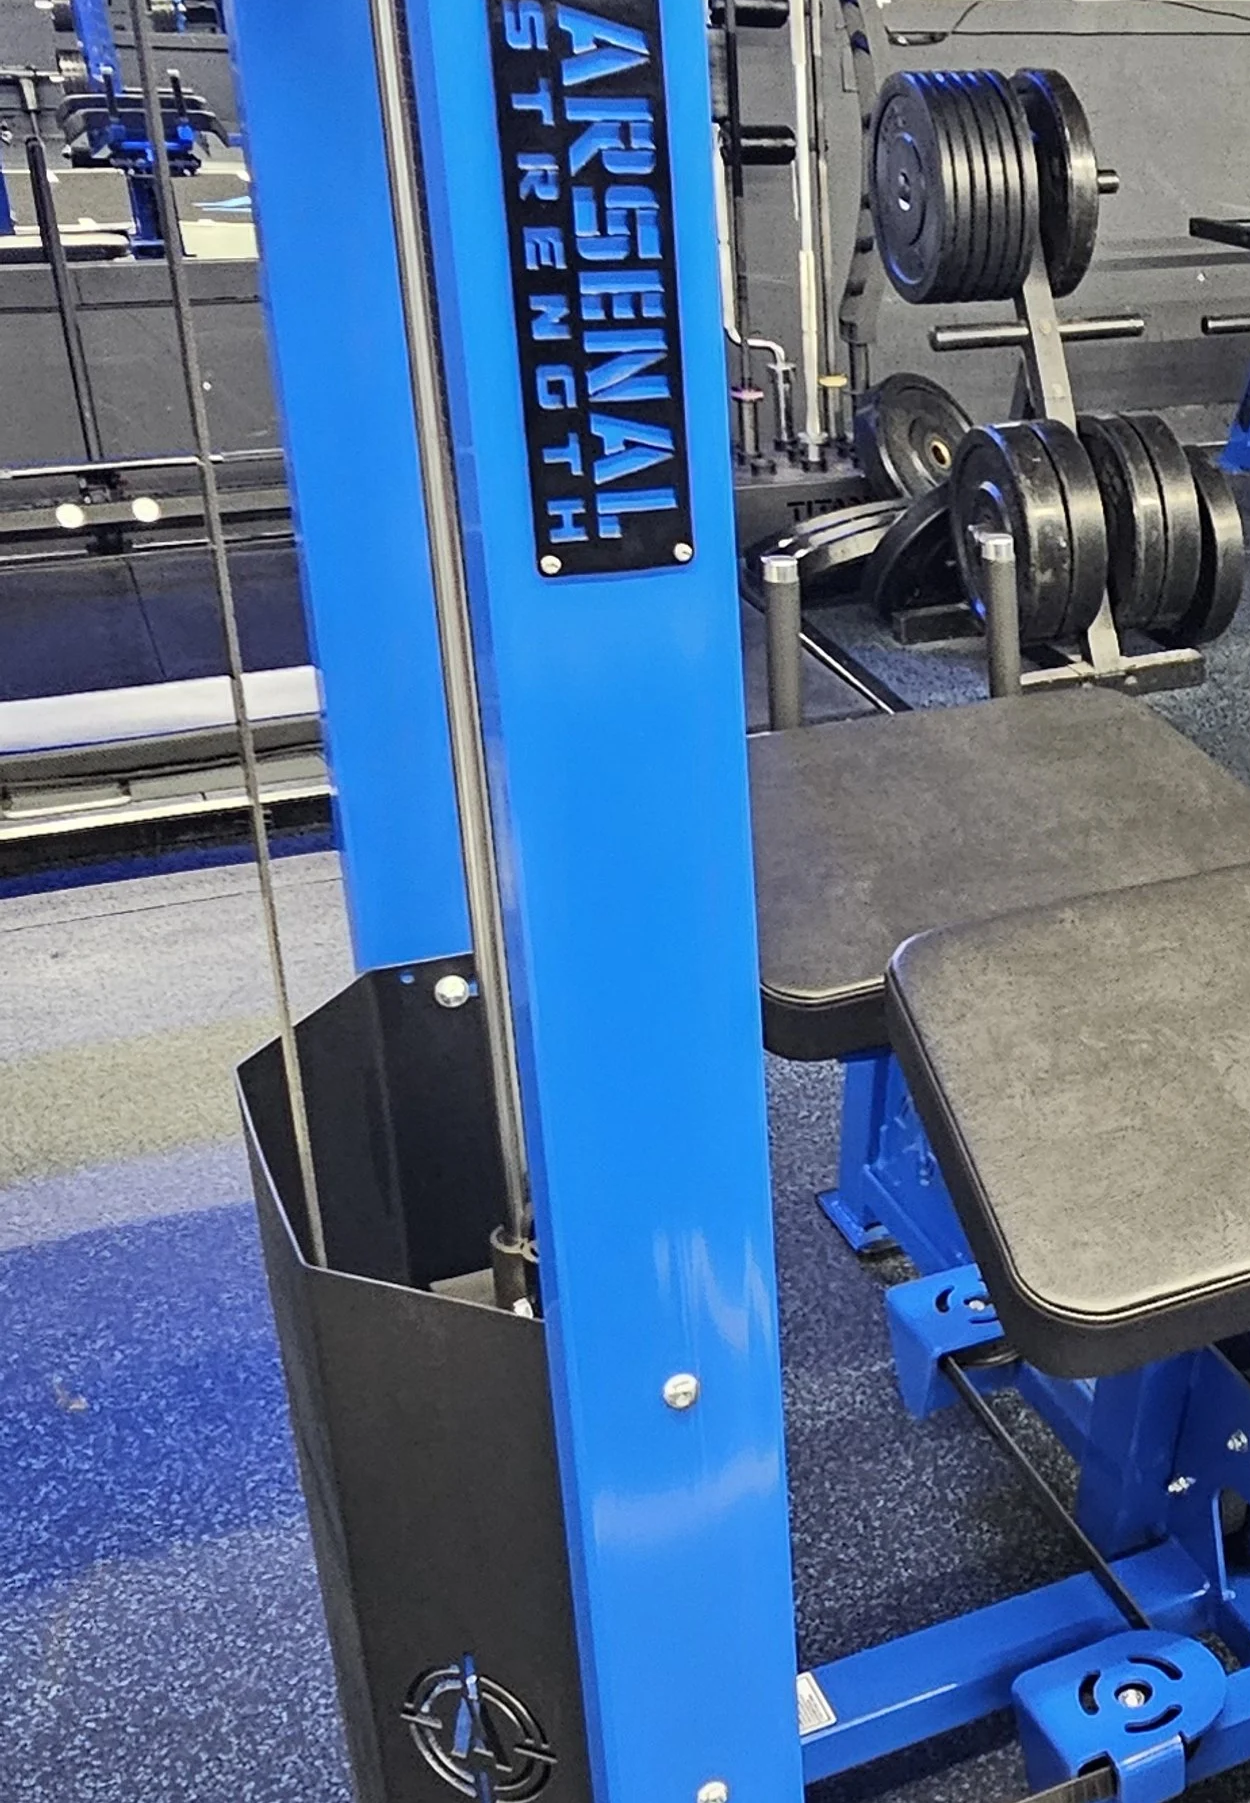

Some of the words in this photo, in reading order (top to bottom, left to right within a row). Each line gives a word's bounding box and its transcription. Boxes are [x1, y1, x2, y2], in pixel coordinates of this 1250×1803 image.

[503, 0, 587, 543] STRENGTH
[557, 4, 678, 540] ARSENAL
[787, 497, 869, 521] TIT
